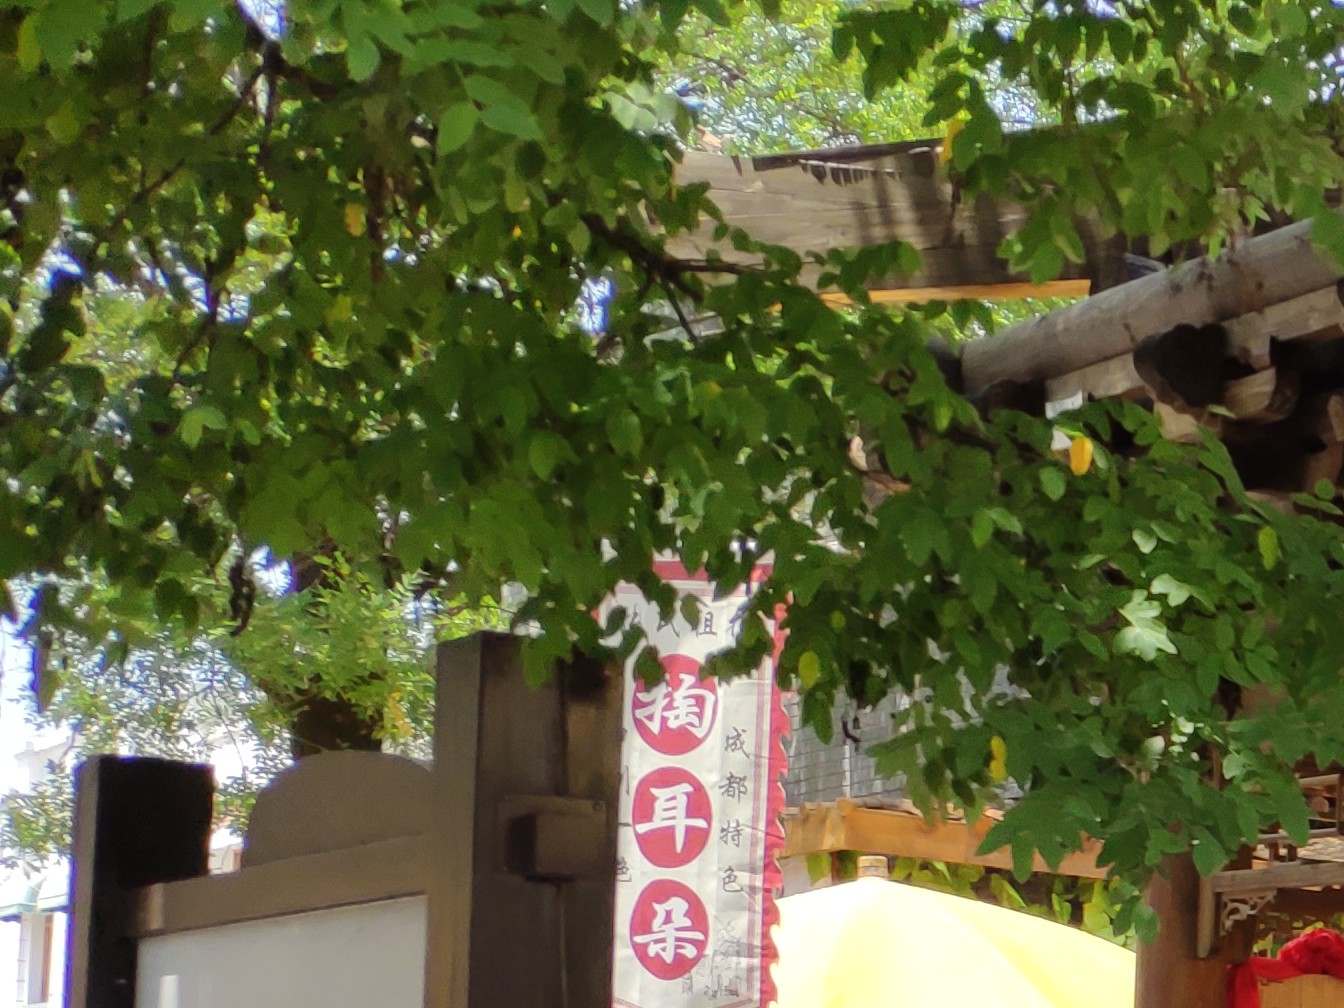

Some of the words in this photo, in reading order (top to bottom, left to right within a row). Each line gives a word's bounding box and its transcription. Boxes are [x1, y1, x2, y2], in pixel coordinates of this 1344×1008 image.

[633, 675, 716, 965] 掏耳朵
[718, 726, 749, 893] 成都特色
